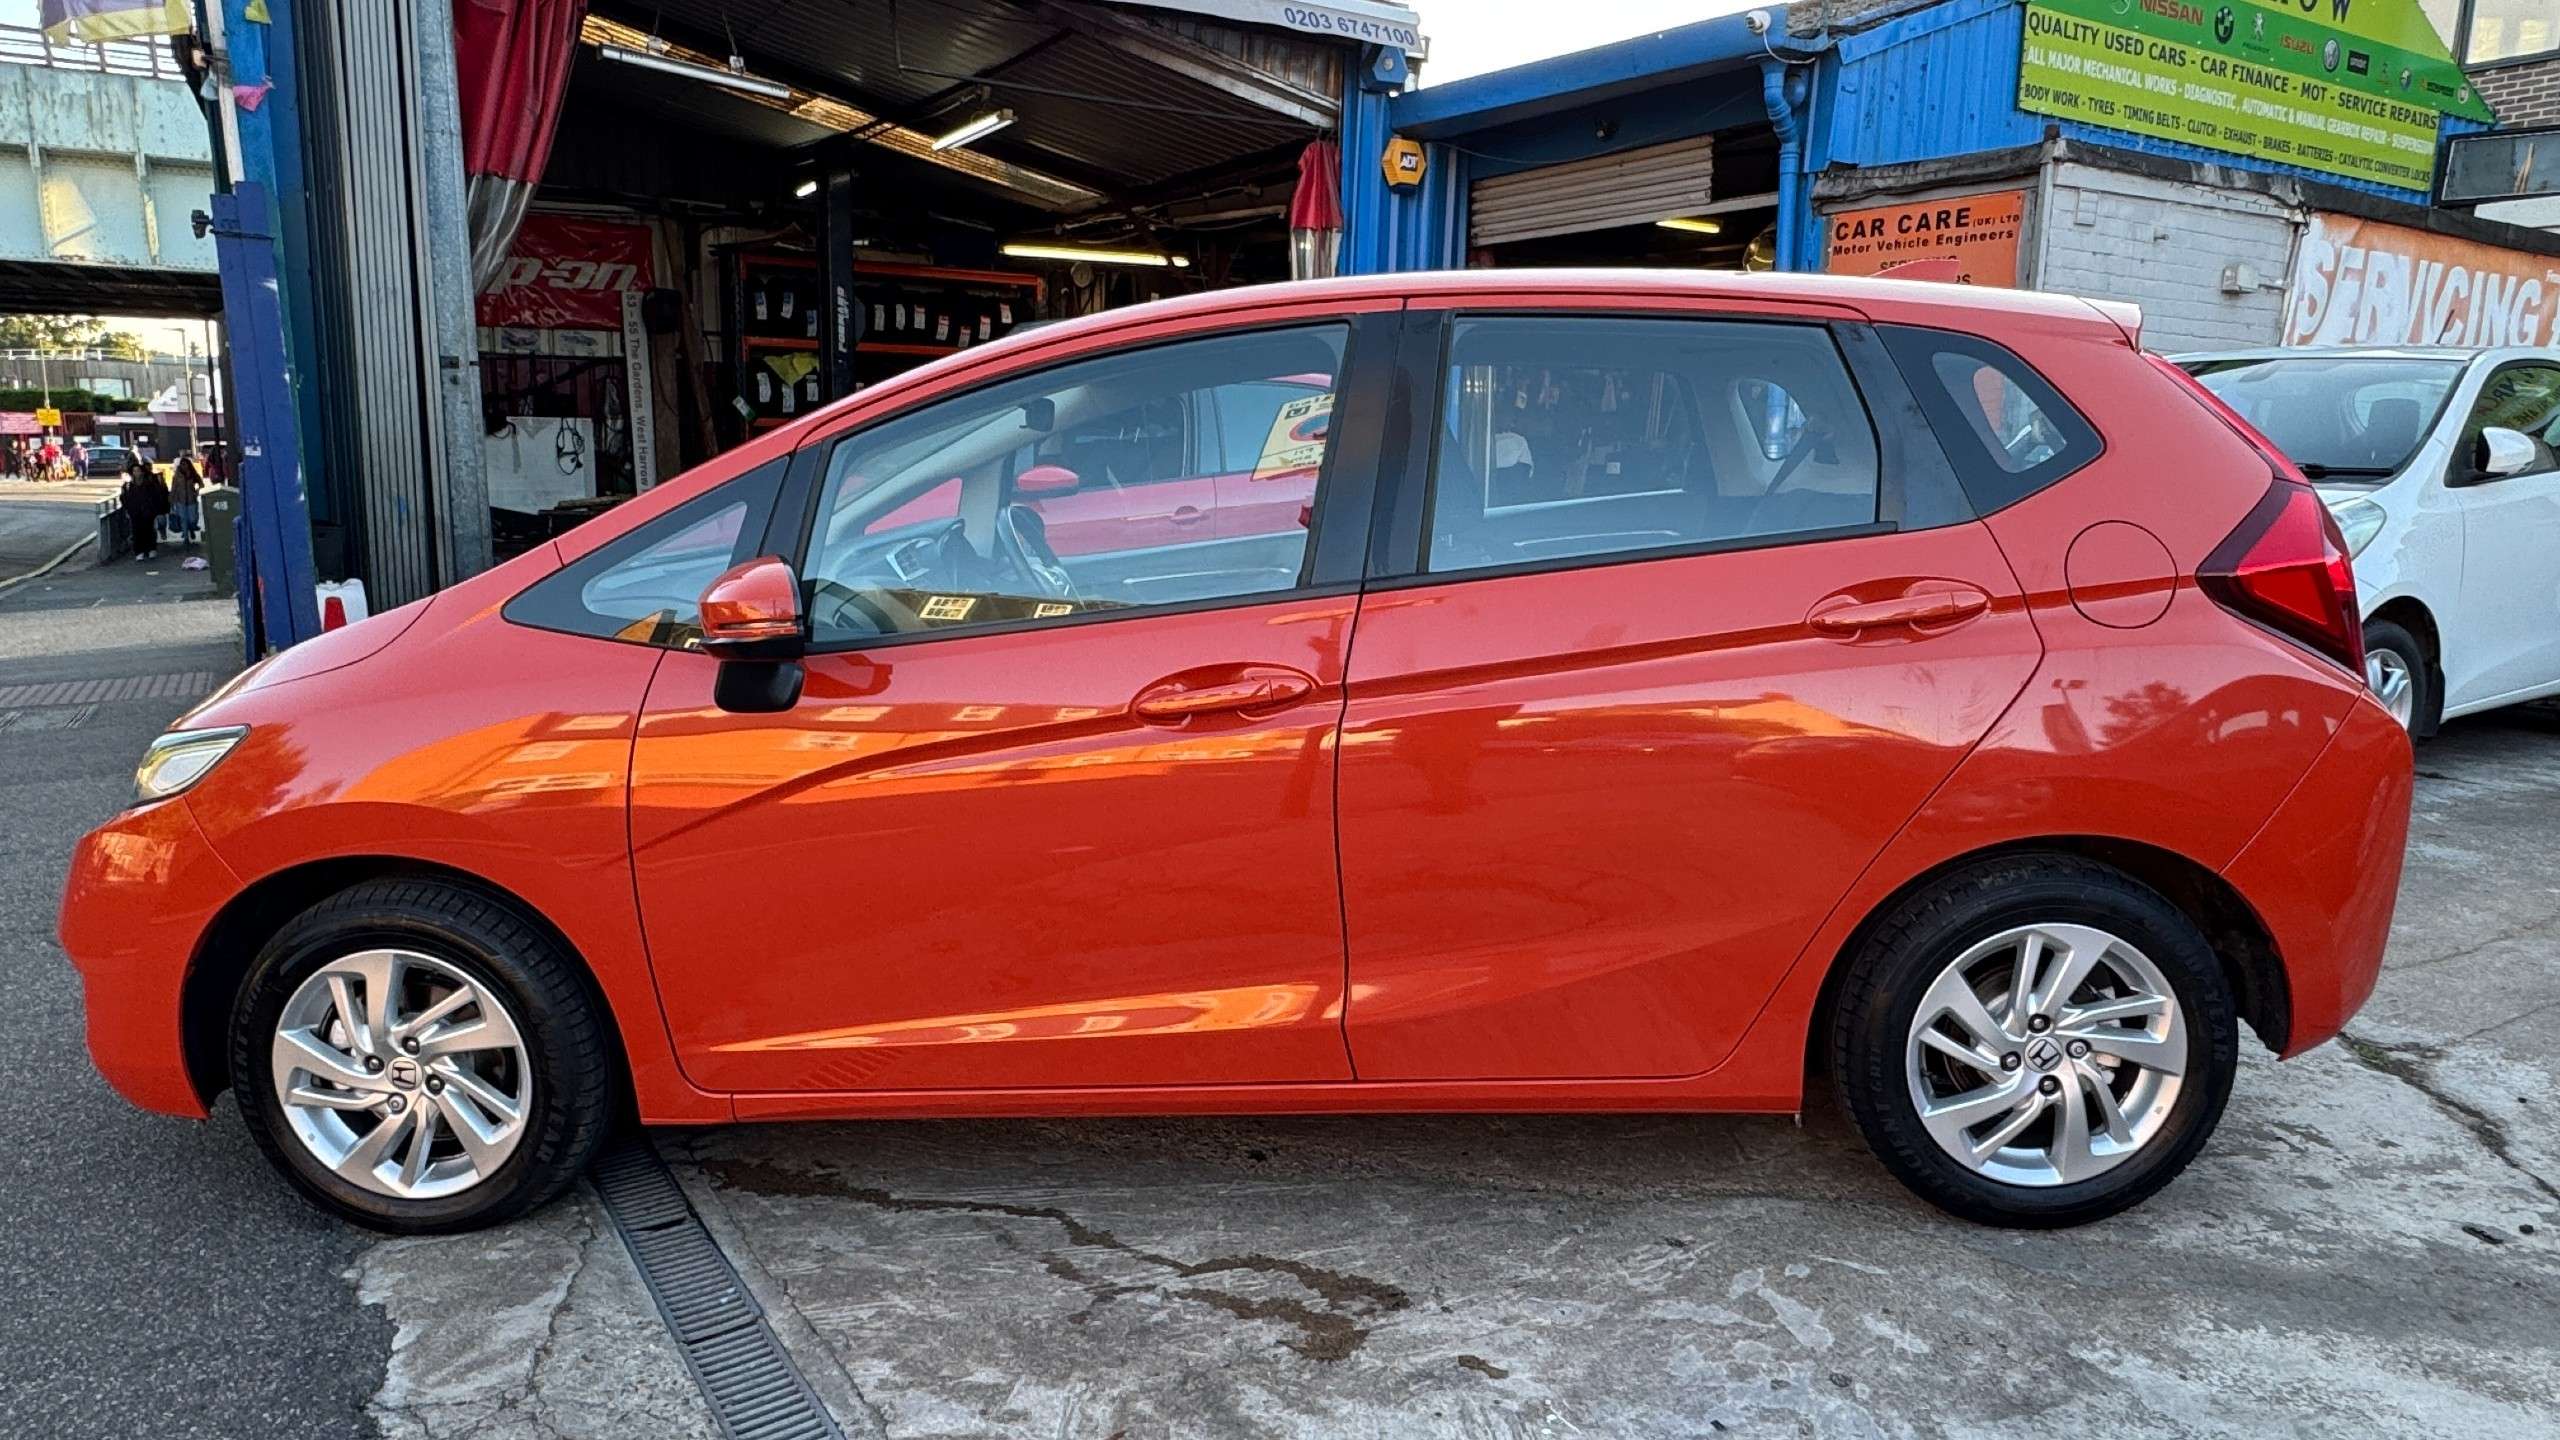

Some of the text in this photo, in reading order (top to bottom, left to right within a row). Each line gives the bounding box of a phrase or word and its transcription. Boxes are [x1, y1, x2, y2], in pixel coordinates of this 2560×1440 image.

[1284, 7, 1415, 46] 0203 6747100
[2140, 0, 2204, 26] NISSAN
[2027, 46, 2046, 66] ALL
[2047, 50, 2082, 75] MAJOR
[2083, 58, 2143, 88] MECHANICAL
[2144, 73, 2178, 96] WORKS
[2241, 97, 2288, 122] AUTOMATIC
[2295, 110, 2326, 131] MANUAL
[2028, 11, 2100, 46] QUALITY
[2104, 31, 2145, 56] USED
[2148, 42, 2187, 67] CARS
[2200, 56, 2228, 78] CAR
[2231, 64, 2290, 94] FINANCE
[2300, 82, 2328, 102] MOT
[2338, 92, 2388, 117] SERVICE
[2389, 105, 2437, 130] REPAIRS
[2024, 83, 2050, 101] BODY
[2052, 89, 2080, 110] WORK
[2088, 97, 2115, 116] TYRES
[2123, 104, 2154, 125] TIMING
[2156, 111, 2181, 130] BELTS
[2187, 119, 2217, 138] CLUTCH
[2223, 126, 2257, 147] EXHAUST
[2263, 135, 2292, 154] BRAKES
[2297, 143, 2334, 163] BATTERIES
[2338, 152, 2373, 172] CATALYTIC
[2374, 160, 2410, 179] CONVERTER
[1400, 154, 1419, 169] ADT
[1832, 229, 2014, 257] Motor Vehicle Engineers
[1835, 207, 2020, 241] CAR CARE (UK) LTD
[486, 256, 638, 294] p-on
[2297, 238, 2542, 347] SERVICING
[629, 338, 640, 358] The
[636, 416, 646, 444] West
[637, 446, 649, 486] Harrow
